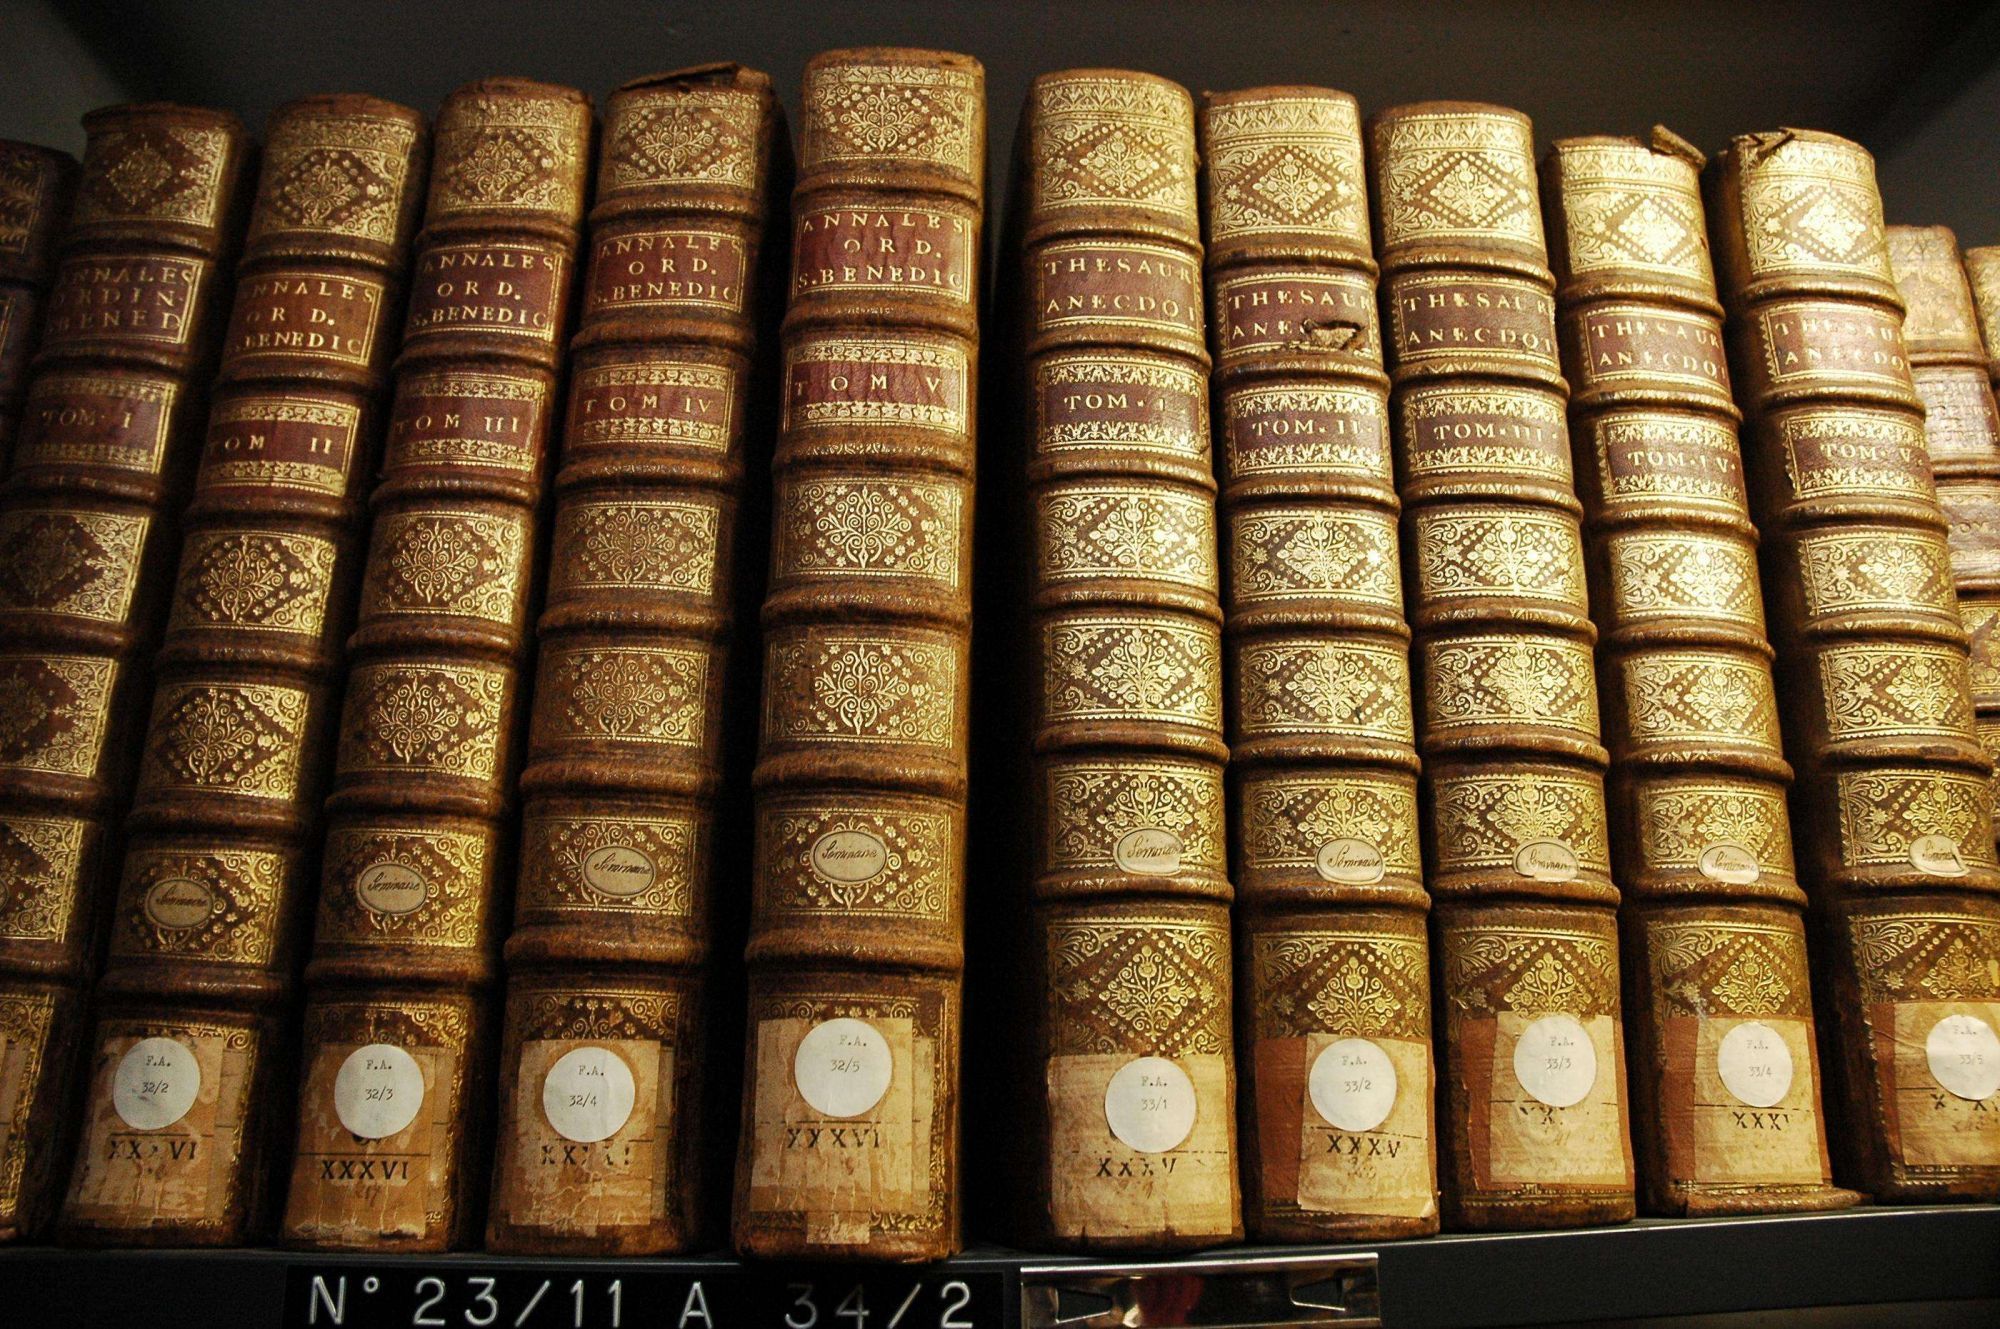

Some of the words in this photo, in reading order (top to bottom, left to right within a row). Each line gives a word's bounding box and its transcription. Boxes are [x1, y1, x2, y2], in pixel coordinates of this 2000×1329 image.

[803, 213, 963, 234] ANNALES
[601, 235, 742, 257] ANNALES
[843, 238, 943, 260] ORD.
[628, 257, 718, 277] ORD.
[1044, 257, 1192, 285] THESAUR
[437, 280, 522, 301] ORD.
[246, 307, 336, 327] ORD.
[1591, 320, 1720, 349] THESAUR
[793, 373, 889, 397] TOM
[925, 376, 943, 395] V
[583, 394, 659, 414] TOM
[684, 396, 714, 414] IV
[123, 411, 133, 429] I
[310, 436, 333, 455] II
[829, 1058, 860, 1075] 32/5
[364, 1087, 394, 1102] 32/3
[1343, 1077, 1372, 1093] 33/2
[568, 1092, 598, 1108] 32/4
[1140, 1097, 1168, 1113] 33/1
[1325, 1133, 1400, 1159] XXXV
[320, 1159, 410, 1180] XXXVI
[308, 1275, 382, 1326] N°
[412, 1275, 622, 1327] 23/11
[678, 1281, 714, 1329] A
[783, 1281, 974, 1329] 34/2
